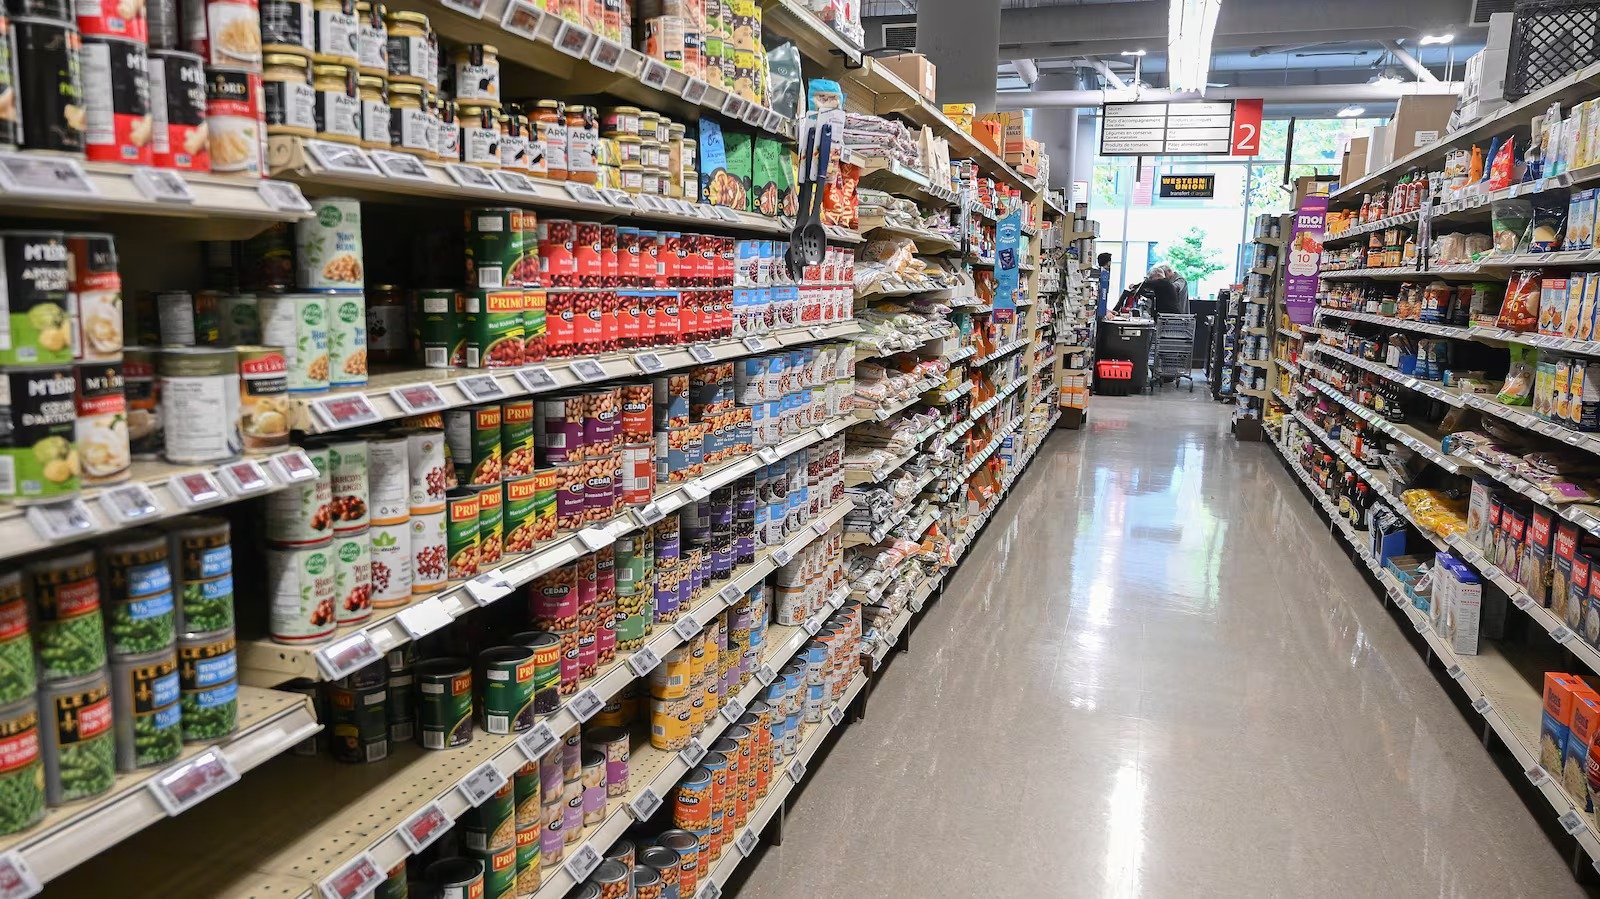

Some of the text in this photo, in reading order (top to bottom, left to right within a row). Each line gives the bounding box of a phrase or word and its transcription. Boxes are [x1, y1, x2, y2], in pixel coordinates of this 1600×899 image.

[1236, 124, 1255, 150] 2
[1298, 214, 1323, 225] moi
[1297, 254, 1311, 263] 10
[622, 402, 647, 412] CEDAR
[588, 477, 611, 486] CEDAR
[543, 586, 570, 595] CEDAR
[678, 796, 699, 804] CEDAR
